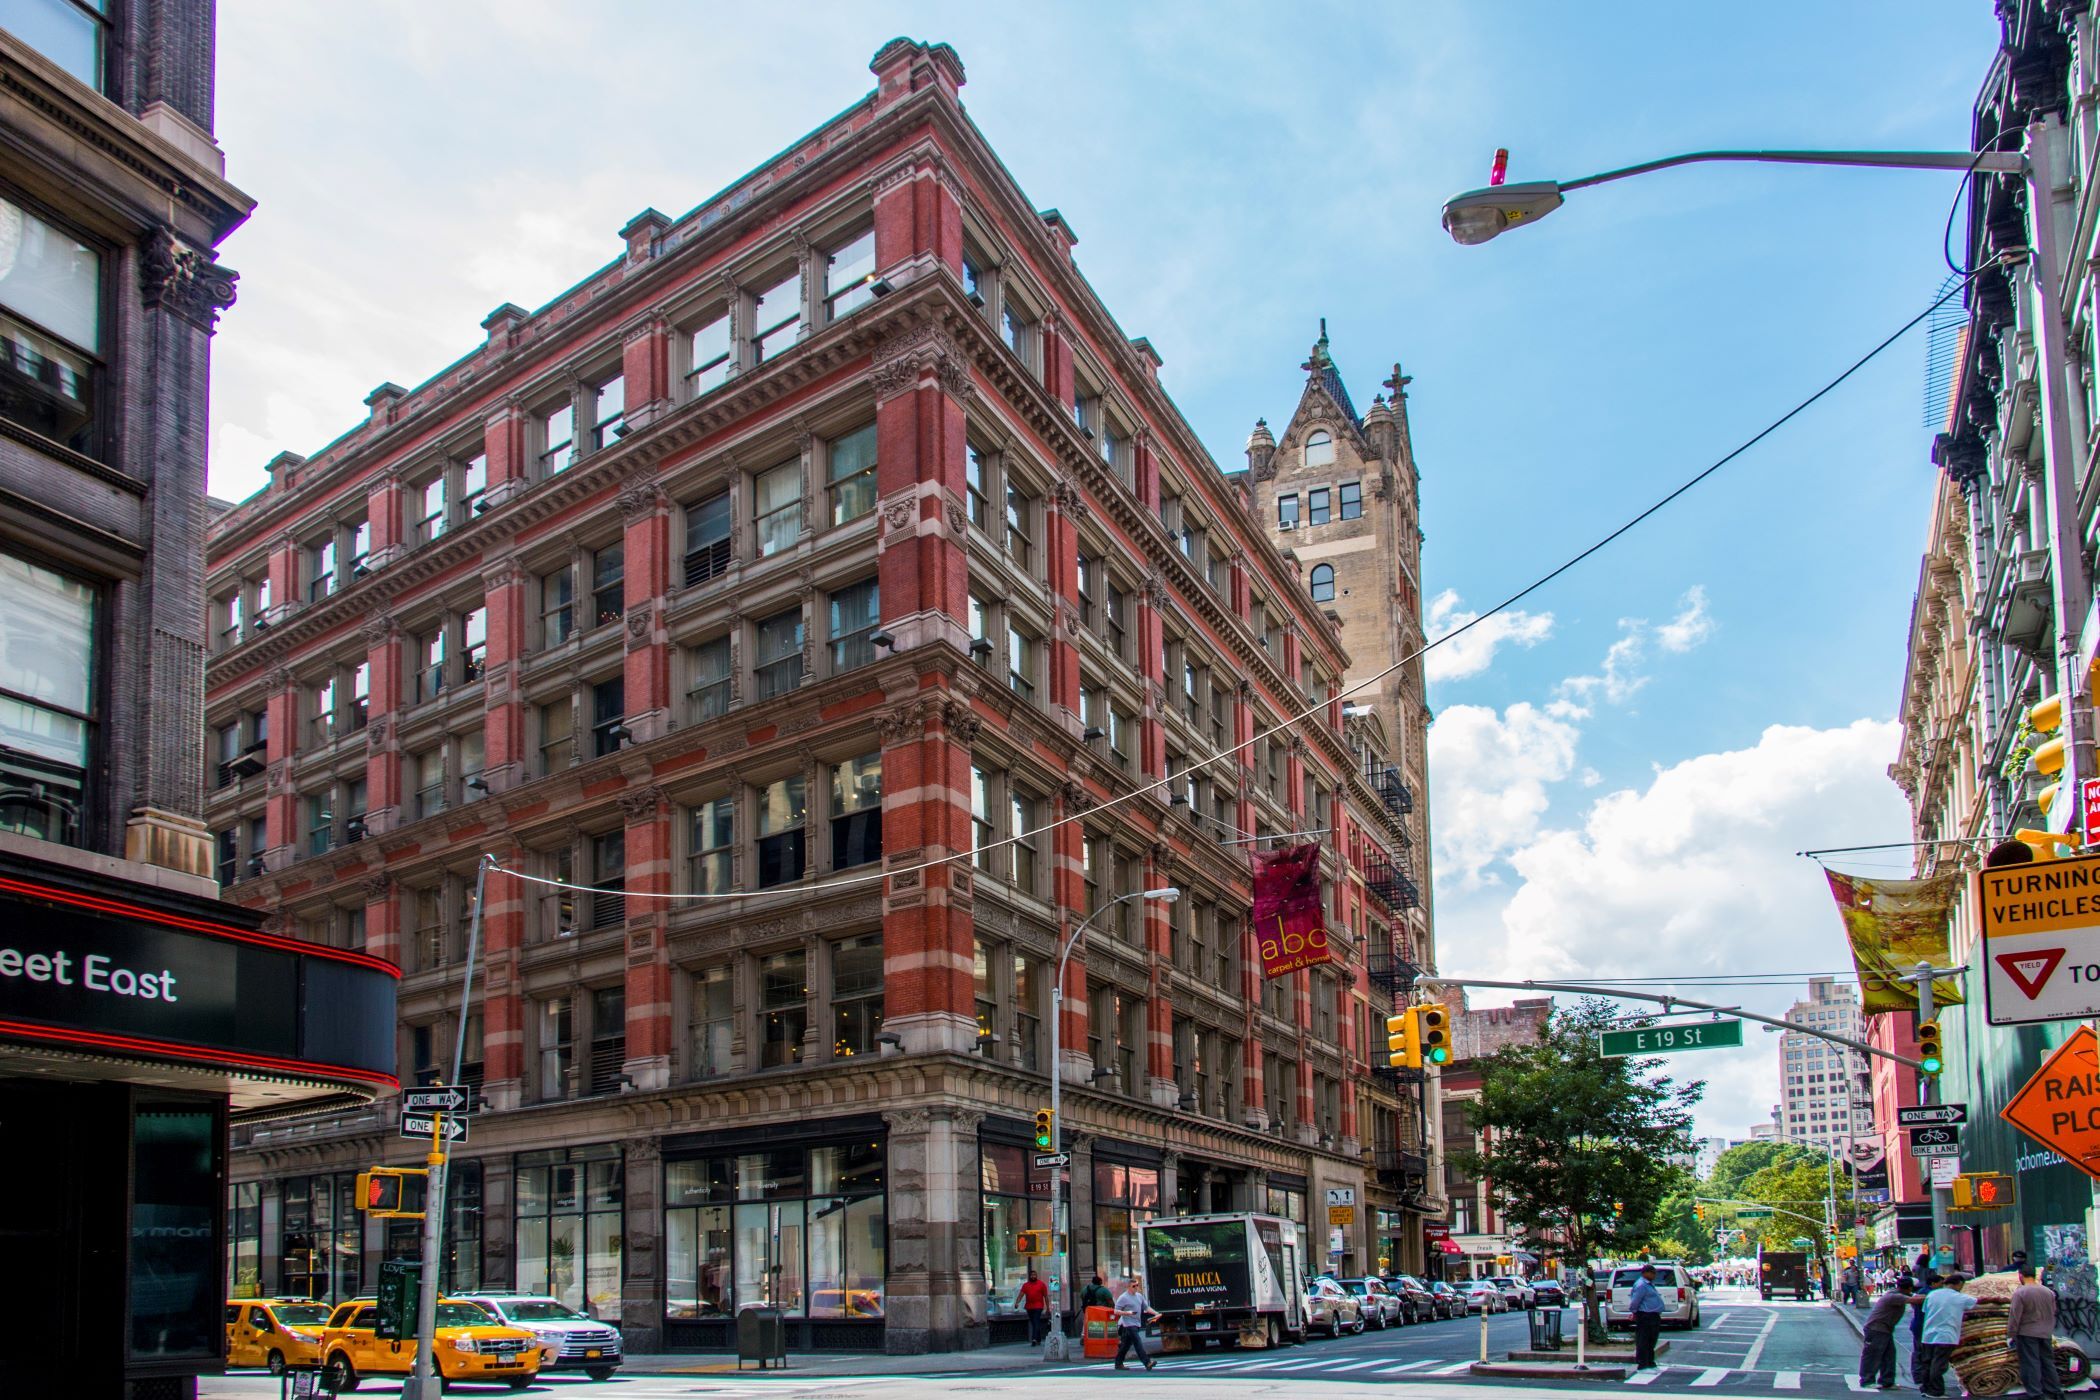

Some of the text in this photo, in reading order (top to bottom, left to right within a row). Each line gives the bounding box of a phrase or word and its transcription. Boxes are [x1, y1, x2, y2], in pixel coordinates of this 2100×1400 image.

[1993, 894, 2100, 924] VEHICLES
[1261, 915, 1328, 960] abc
[1268, 961, 1293, 975] carpet
[1295, 956, 1304, 967] &
[2020, 961, 2041, 970] YIELD
[2069, 964, 2100, 983] TO
[84, 954, 178, 1002] East
[1637, 1028, 1702, 1048] E 19 St
[412, 1094, 458, 1105] ONE WAY
[1906, 1110, 1957, 1120] ONE WAY
[410, 1120, 430, 1131] ONE
[1913, 1144, 1957, 1154] BIKE LANE
[1175, 1271, 1222, 1288] TRIACCA
[1170, 1284, 1228, 1295] DALLA MIA VIGNA
